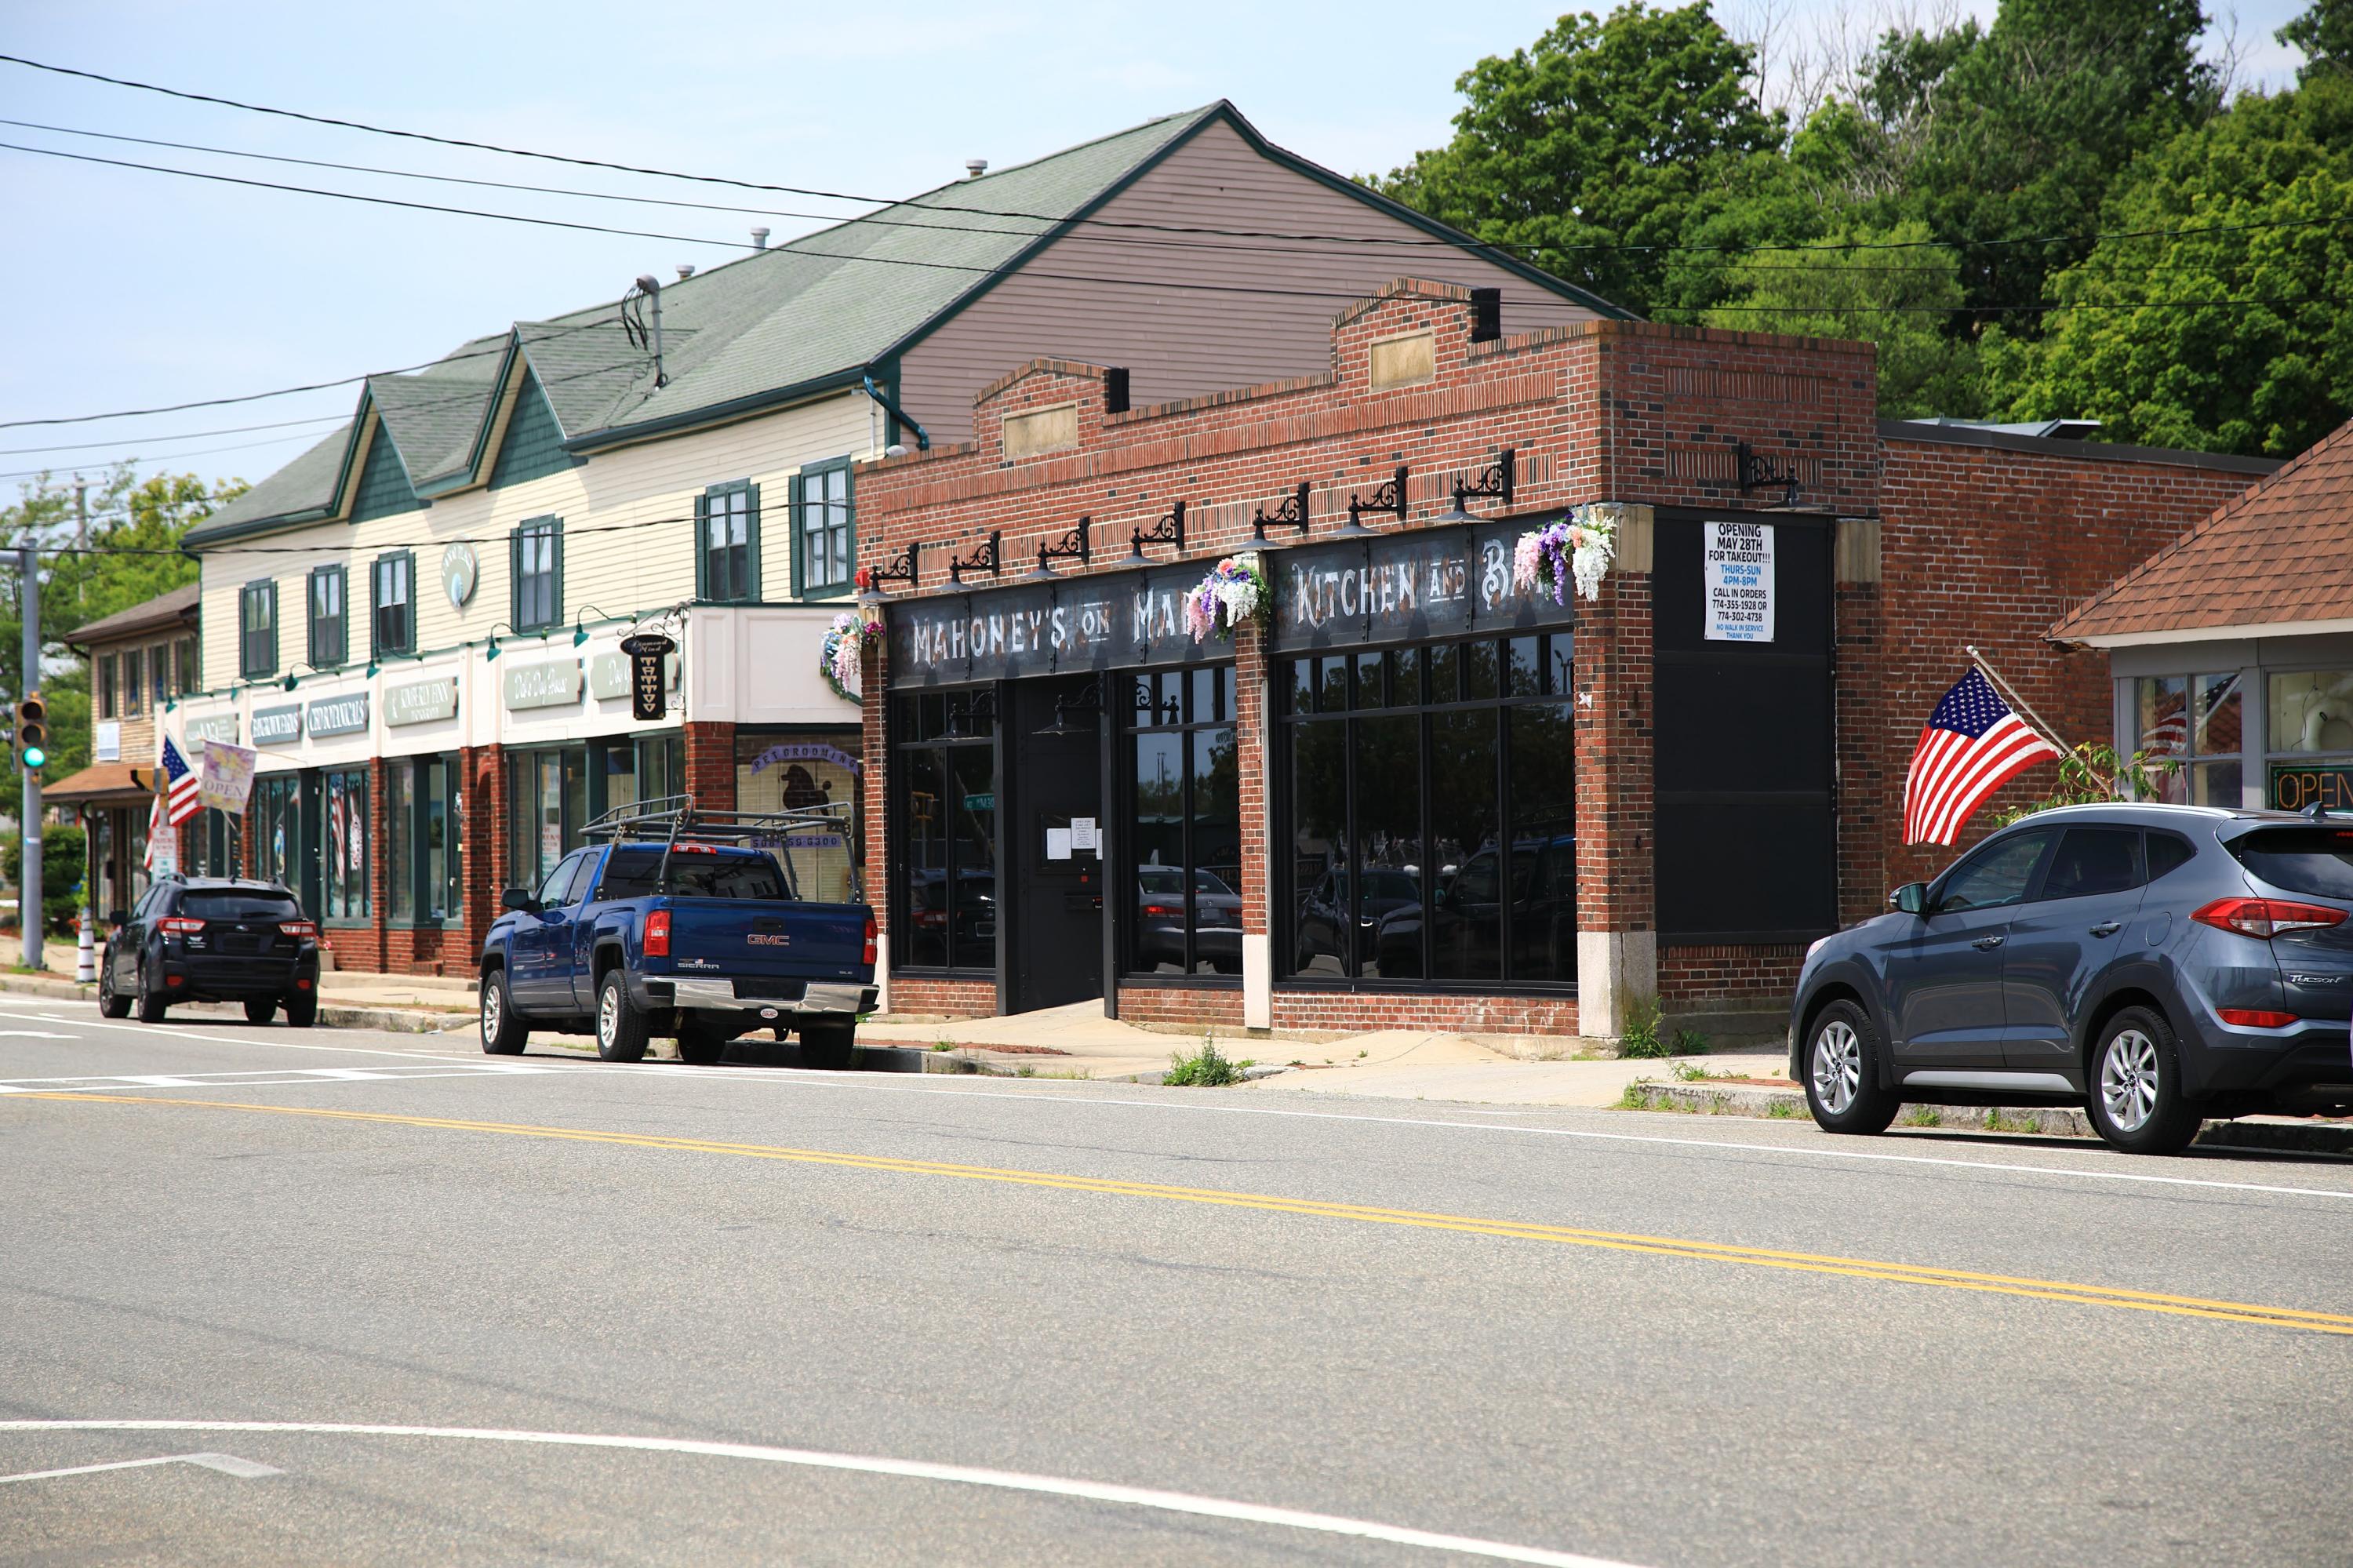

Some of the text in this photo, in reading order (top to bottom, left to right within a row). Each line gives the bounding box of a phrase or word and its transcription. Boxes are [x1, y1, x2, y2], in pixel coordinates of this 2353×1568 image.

[1718, 523, 1762, 537] OPENING
[1717, 537, 1762, 551] MAY 28TH
[1708, 550, 1770, 563] FOR TAKEOUT!!!
[1720, 564, 1762, 576] THURS-SUN
[1723, 576, 1758, 587] 4PM-8PM
[1291, 562, 1417, 631] KITCHEN
[1429, 565, 1466, 597] AND
[1713, 588, 1767, 599] CALL IN ORDERS
[1712, 599, 1767, 611] 774-355-1928 OR
[1718, 611, 1763, 622] 774-302-4738
[911, 607, 1067, 669] MAHONEY'S
[1082, 609, 1111, 636] ON
[639, 657, 658, 713] TATTOO
[754, 748, 857, 769] PET GROOMING
[204, 779, 245, 798] OPEN
[2278, 773, 2353, 809] OPEN
[747, 934, 791, 946] GMC
